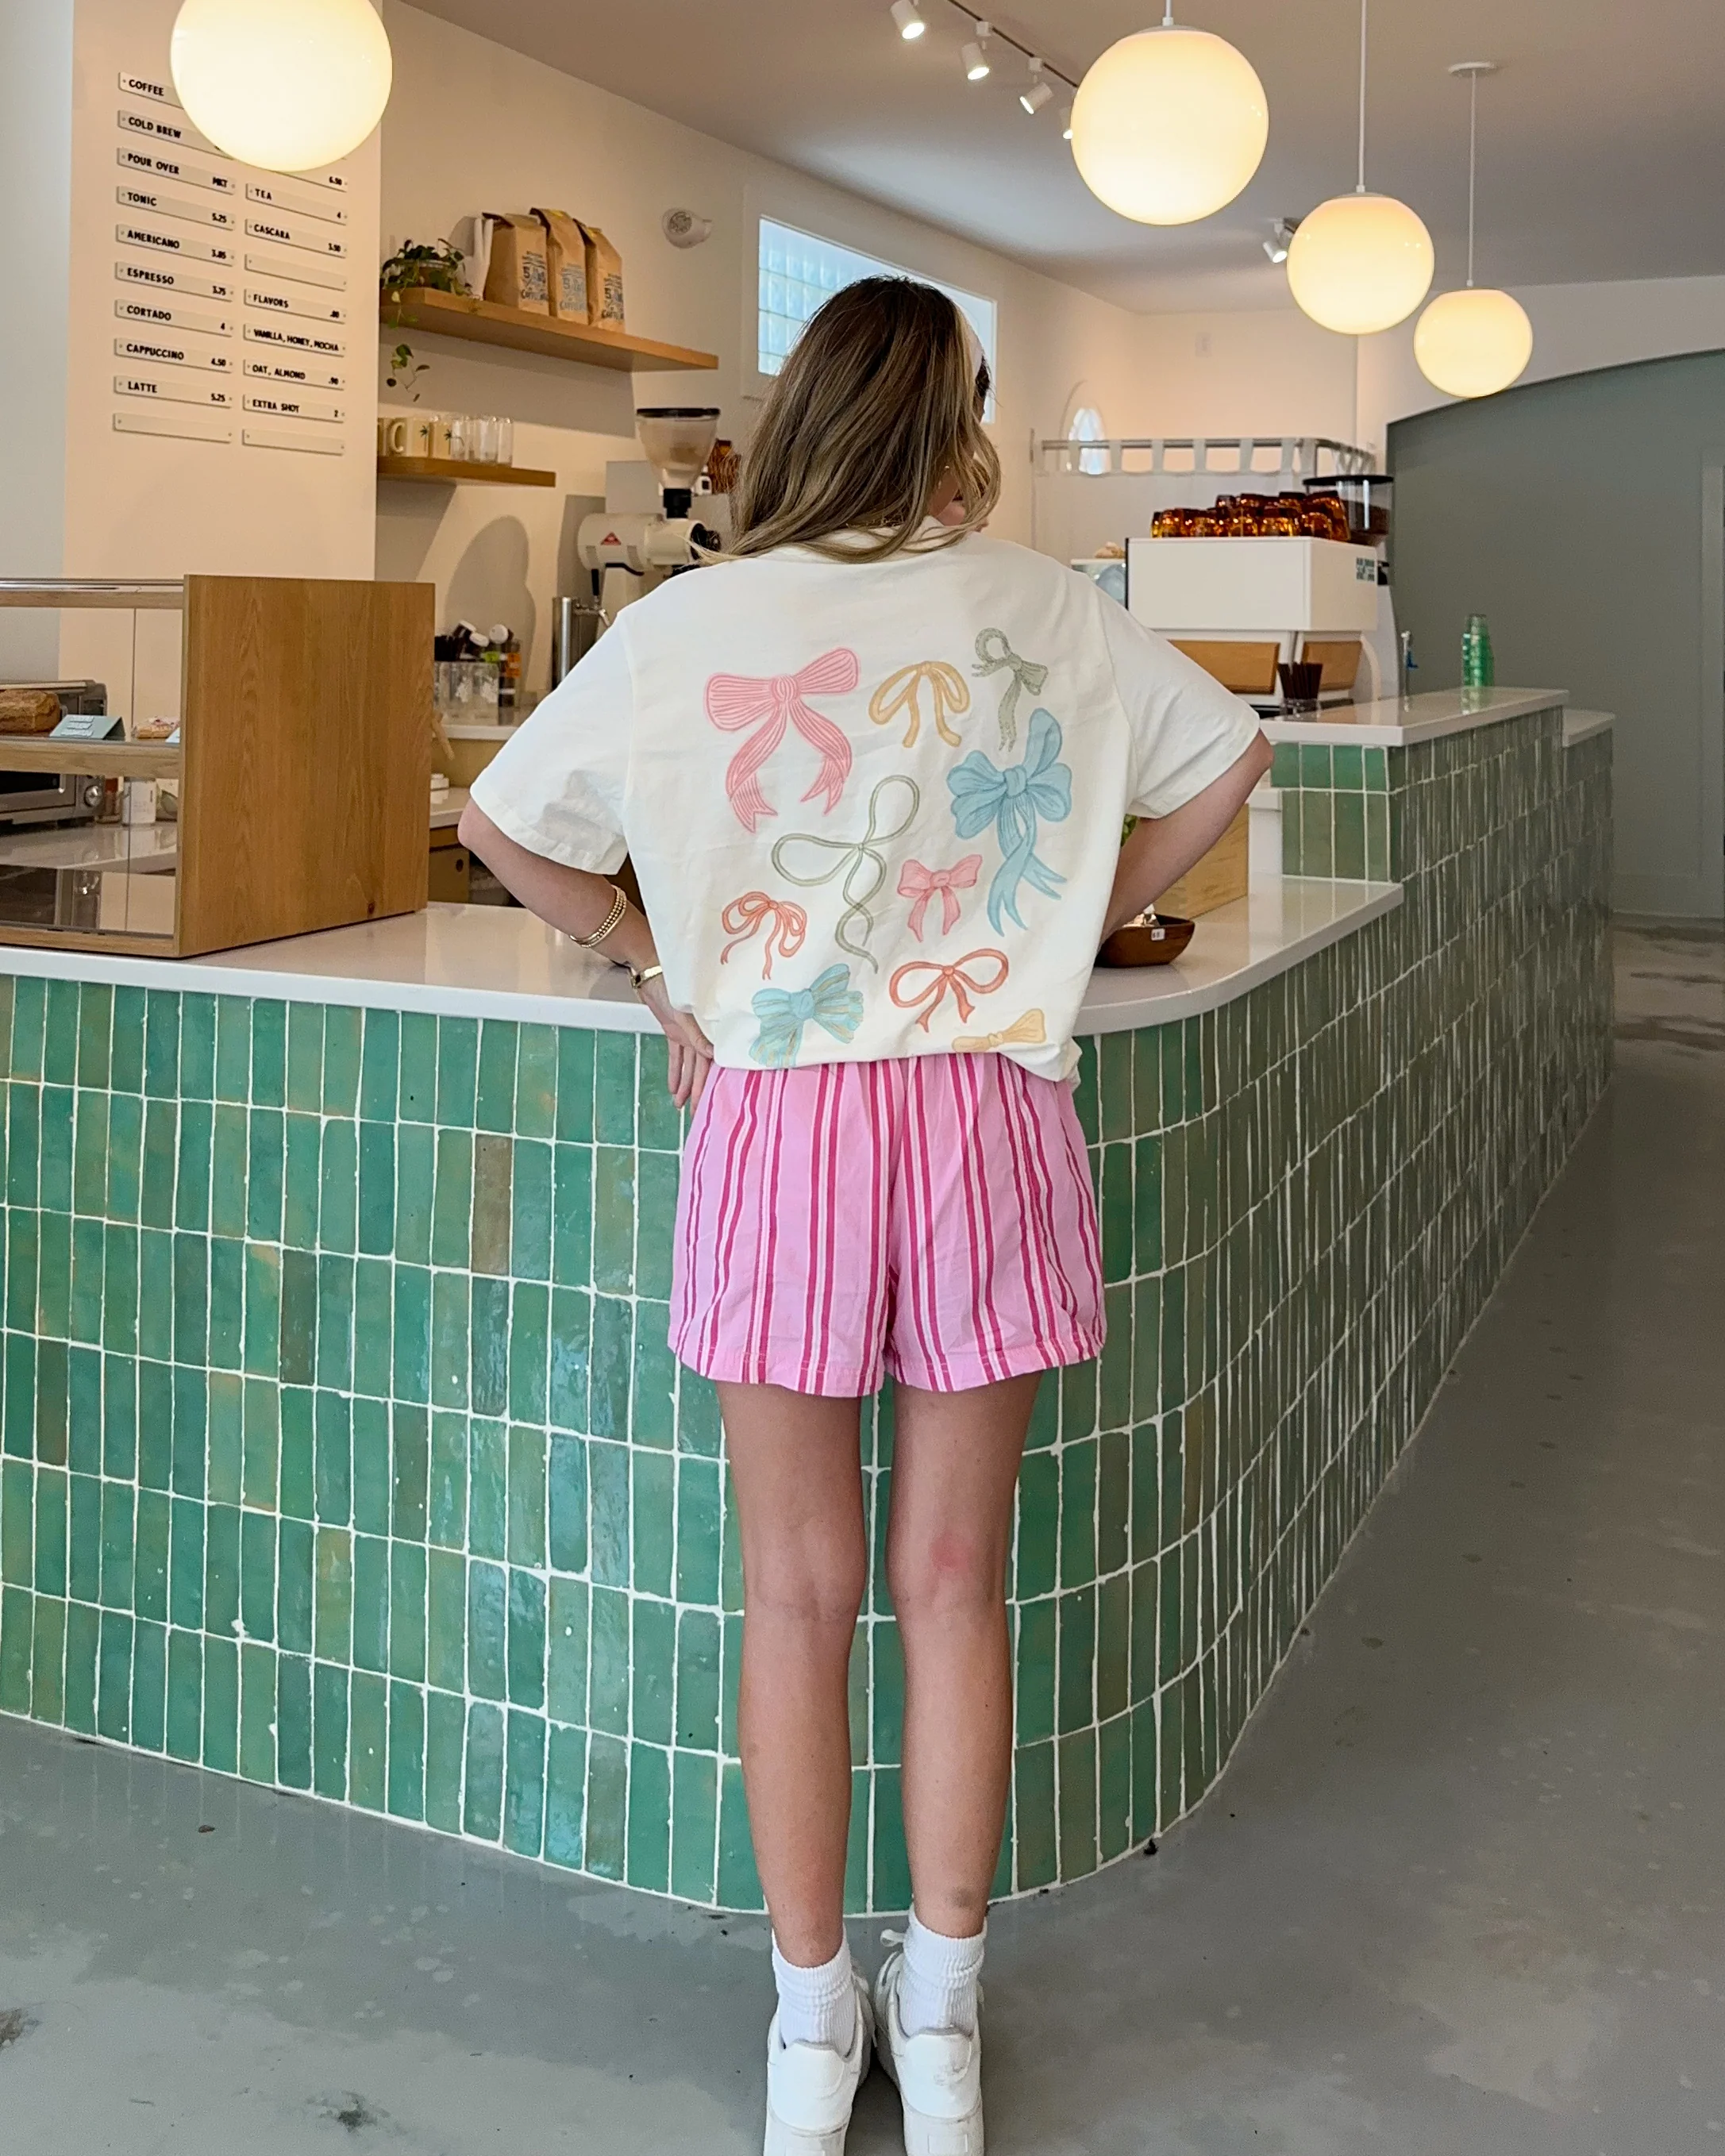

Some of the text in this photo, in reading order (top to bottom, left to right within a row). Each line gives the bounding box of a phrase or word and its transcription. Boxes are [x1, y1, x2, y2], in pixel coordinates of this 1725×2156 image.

[129, 79, 164, 96] COFFEE
[129, 116, 182, 139] COLD BREW
[128, 152, 152, 167] POUR
[156, 161, 179, 175] OVER
[255, 188, 272, 200] TEA
[127, 191, 227, 224] TONIC 5.25
[127, 229, 180, 249] AMERICANO
[253, 224, 291, 241] CASCARA
[127, 267, 175, 285] ESPRESSO
[253, 294, 289, 309] FLAVORS
[127, 305, 225, 330] CORTADO 4
[253, 329, 339, 352] VANILLA, HONEY, MOCHA
[126, 343, 184, 360] CAPPUCCINO
[252, 364, 271, 376] OAT,
[274, 368, 306, 380] ALMOND
[127, 381, 225, 402] LATTE 5.25
[252, 398, 278, 410] EXTRA
[280, 403, 300, 413] SHOT
